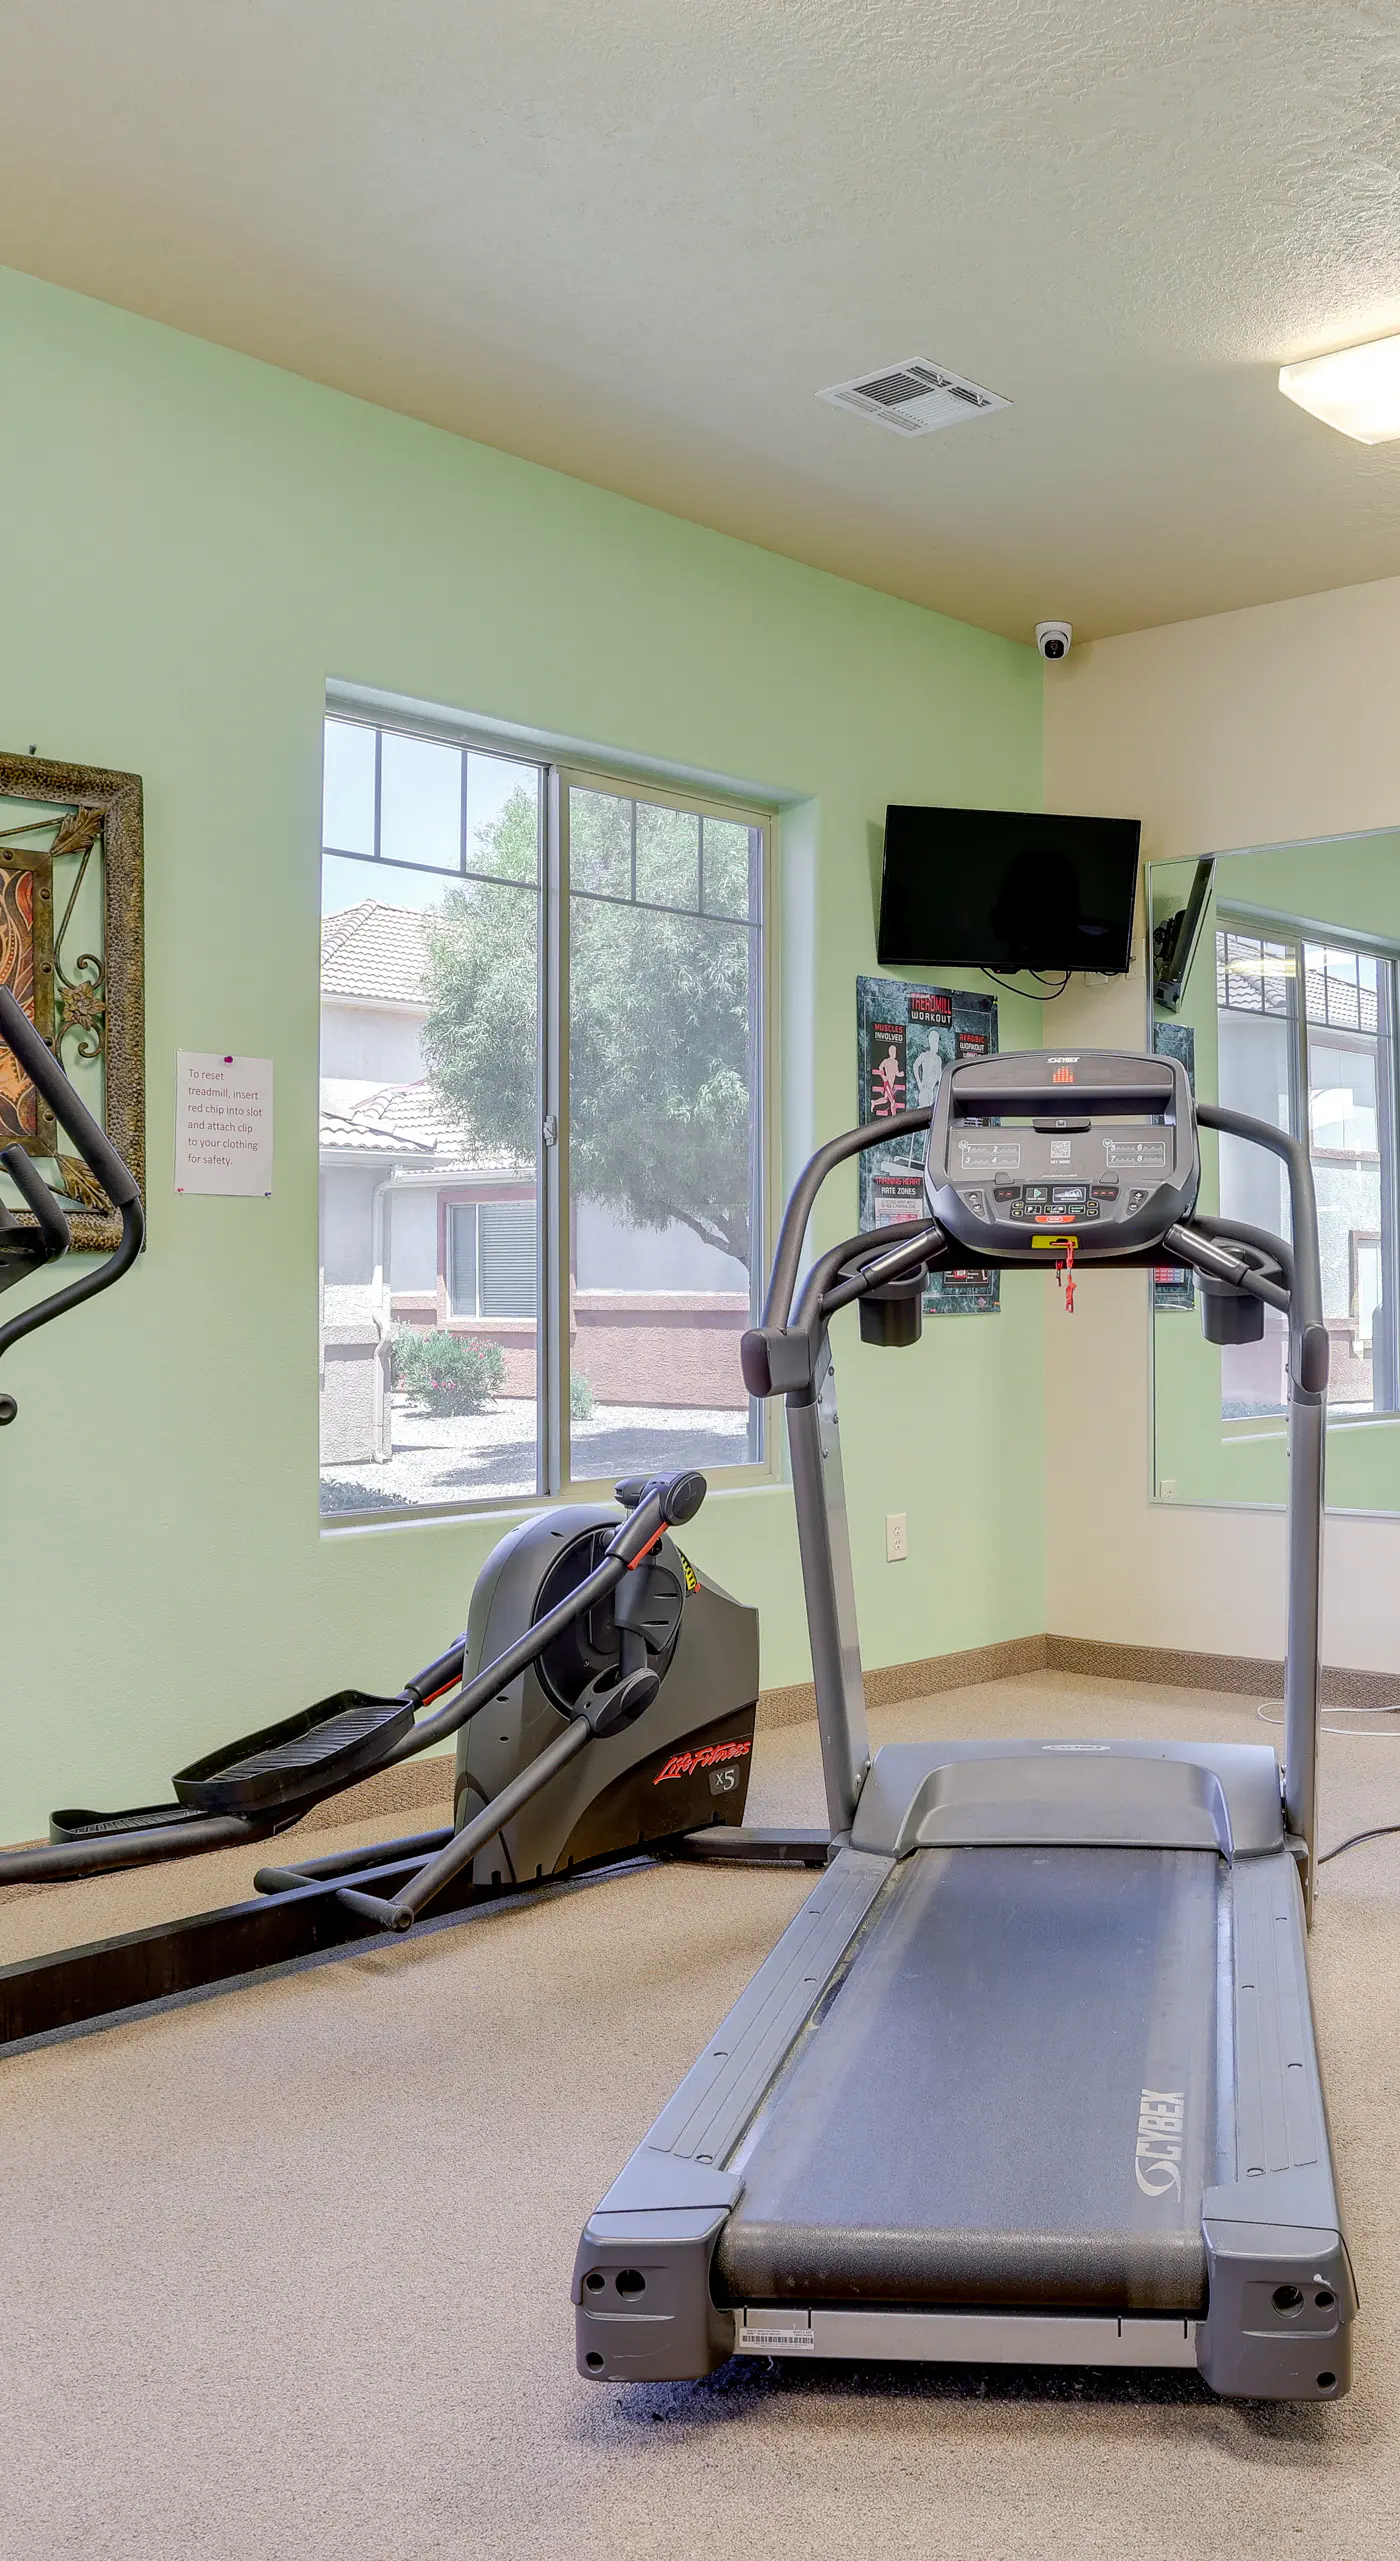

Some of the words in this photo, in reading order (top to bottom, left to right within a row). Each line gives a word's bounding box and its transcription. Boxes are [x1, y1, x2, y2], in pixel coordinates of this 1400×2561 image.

[911, 993, 952, 1014] TREADMILL
[911, 1010, 952, 1024] WORKOUT
[874, 1024, 903, 1034] MUSCLES
[875, 1032, 903, 1042] INVOLVED
[959, 1033, 985, 1044] AEROBIC
[960, 1042, 985, 1052] WORKOUT
[188, 1069, 200, 1078] To
[202, 1070, 224, 1080] reset
[188, 1087, 231, 1099] treadmill,
[233, 1090, 259, 1100] insert
[188, 1104, 203, 1113] red
[205, 1105, 225, 1115] chip
[226, 1106, 244, 1116] into
[246, 1107, 262, 1117] slot
[188, 1121, 205, 1130] and
[207, 1122, 235, 1132] attach
[238, 1123, 253, 1134] clip
[188, 1138, 198, 1146] to
[200, 1139, 221, 1148] your
[222, 1139, 258, 1151] clothing
[188, 1154, 201, 1164] for
[203, 1155, 233, 1166] safety.
[903, 1177, 921, 1186] HEART
[881, 1186, 896, 1194] RATE
[897, 1187, 916, 1195] ZONES
[1136, 2088, 1184, 2161] CYBEX
